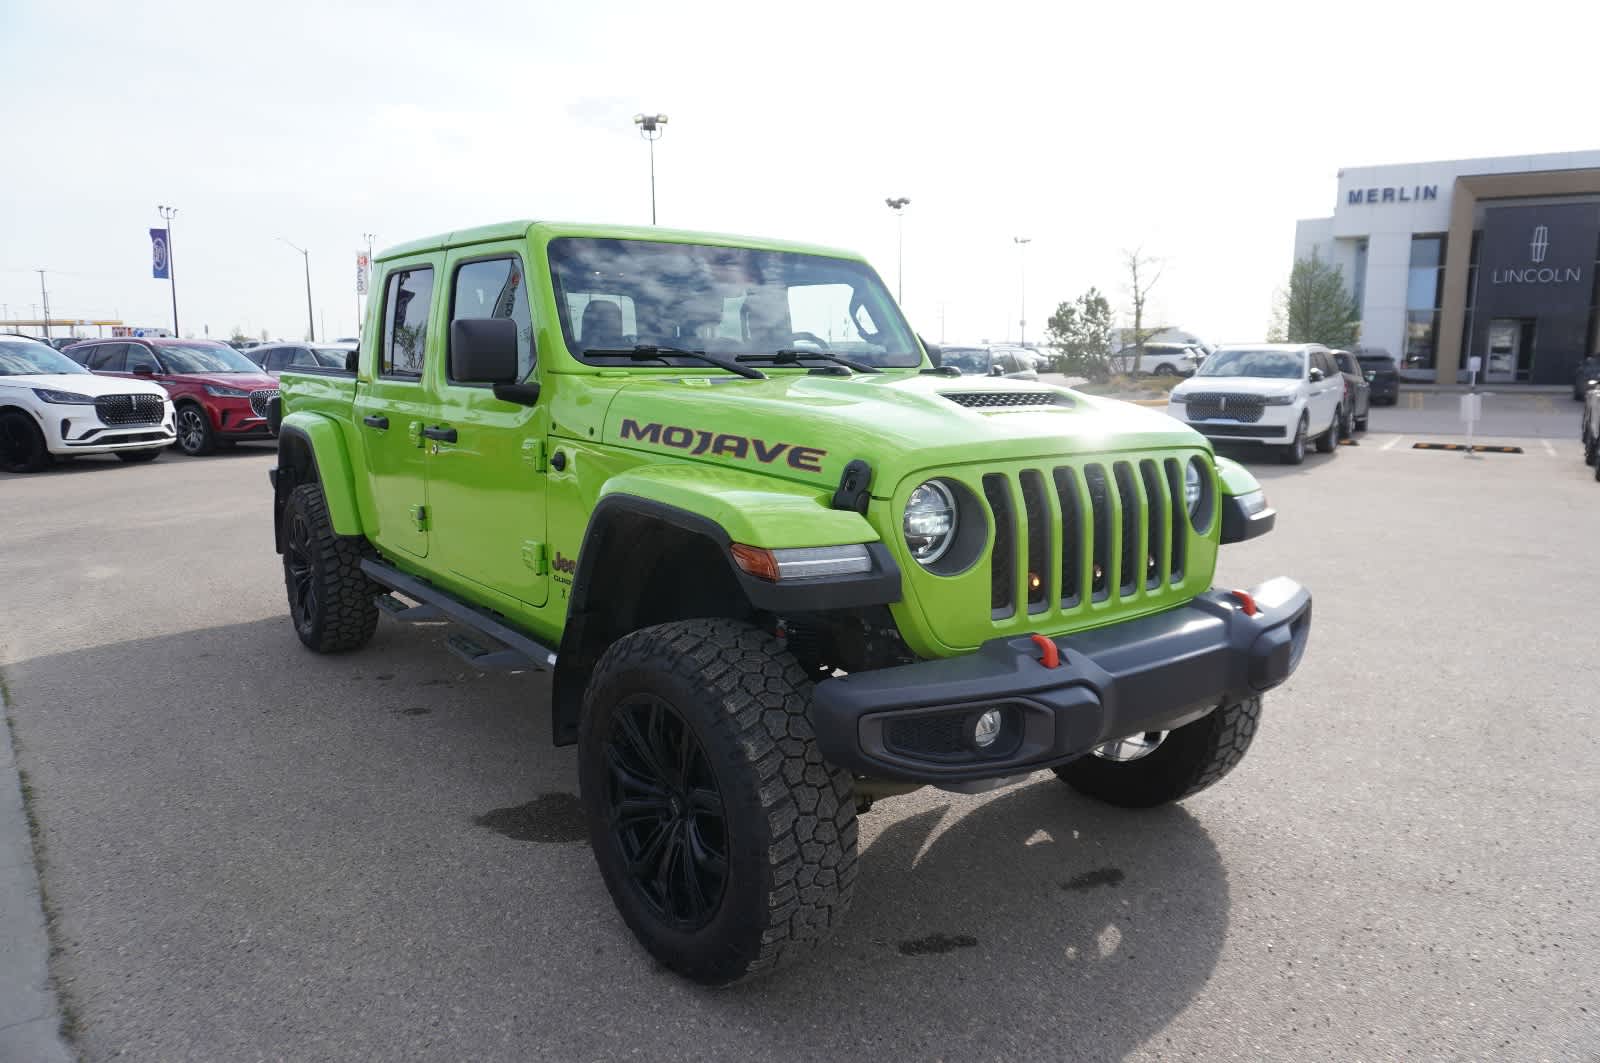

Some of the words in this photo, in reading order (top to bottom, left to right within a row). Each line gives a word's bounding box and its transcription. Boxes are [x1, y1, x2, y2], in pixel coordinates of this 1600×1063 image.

[1348, 185, 1438, 203] MERLIN
[1493, 267, 1581, 284] LINCOLN
[620, 418, 827, 473] MOJAVE
[552, 551, 576, 575] Jee
